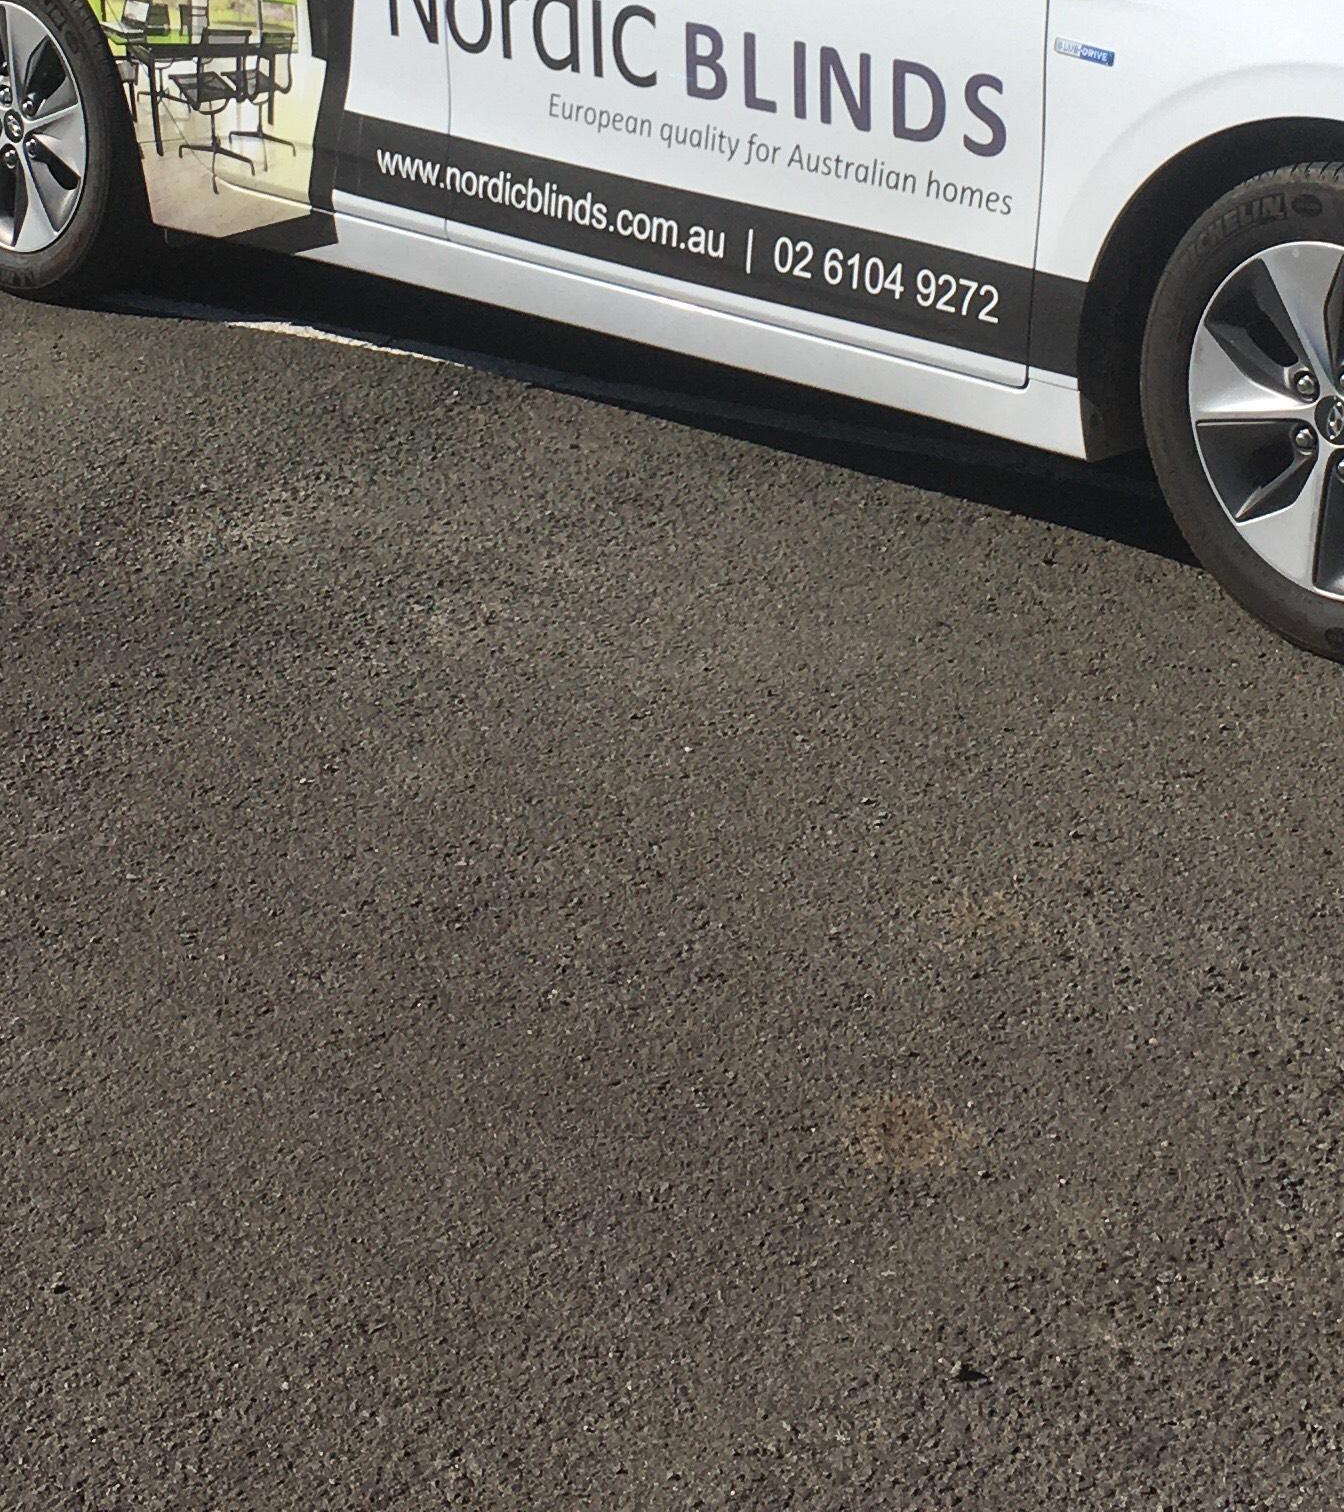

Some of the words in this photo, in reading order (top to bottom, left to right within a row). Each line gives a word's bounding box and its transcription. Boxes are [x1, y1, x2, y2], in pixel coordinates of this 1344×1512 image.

[548, 93, 652, 138] European
[659, 120, 741, 163] quality
[744, 133, 782, 166] for
[787, 144, 917, 194] Australian
[925, 170, 1014, 215] homes
[685, 21, 1008, 158] BLINDS
[376, 148, 726, 259] www.nordicblinds.com.au
[774, 236, 813, 279] 02
[823, 248, 905, 300] 6104
[916, 269, 1001, 324] 9272
